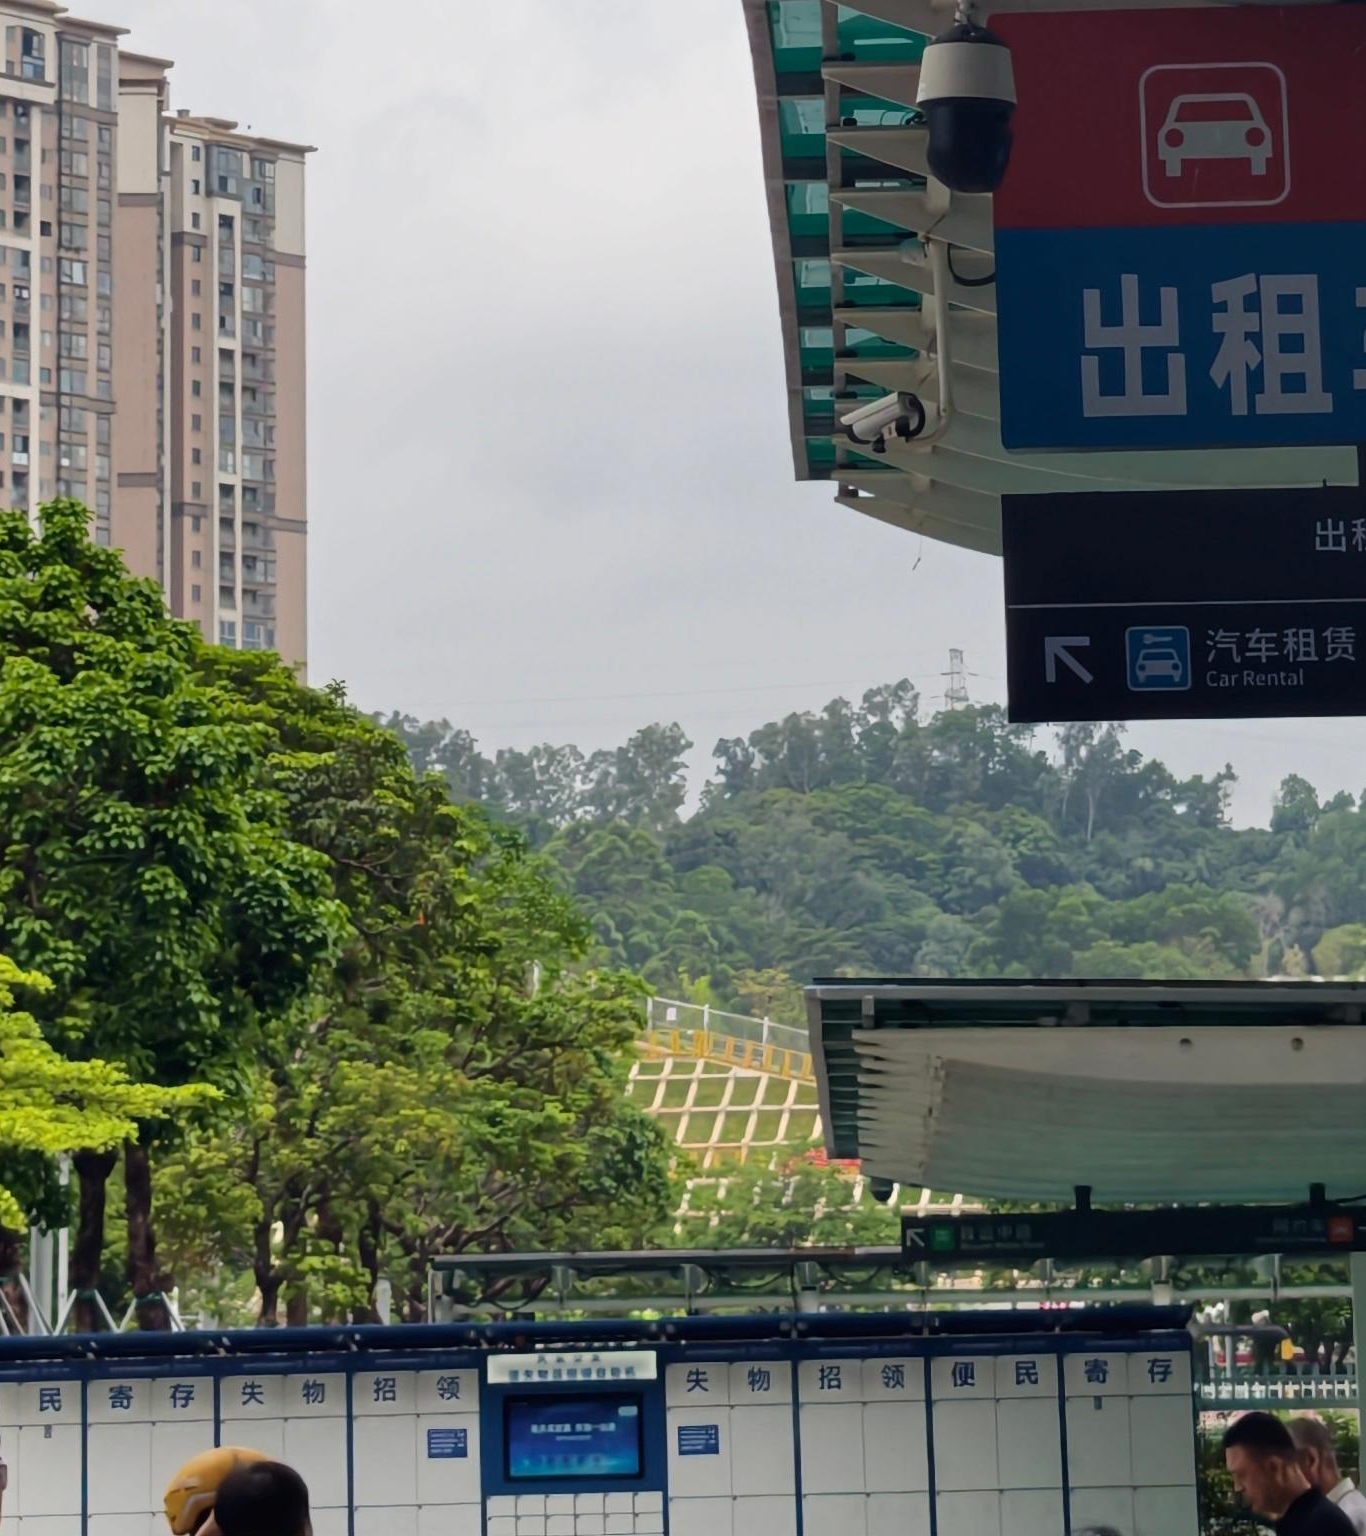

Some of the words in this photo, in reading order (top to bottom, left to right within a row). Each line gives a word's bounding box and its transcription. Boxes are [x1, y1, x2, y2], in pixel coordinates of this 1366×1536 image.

[1205, 626, 1357, 664] 汽车租赁
[1206, 671, 1238, 687] Car
[1243, 668, 1304, 686] Rental
